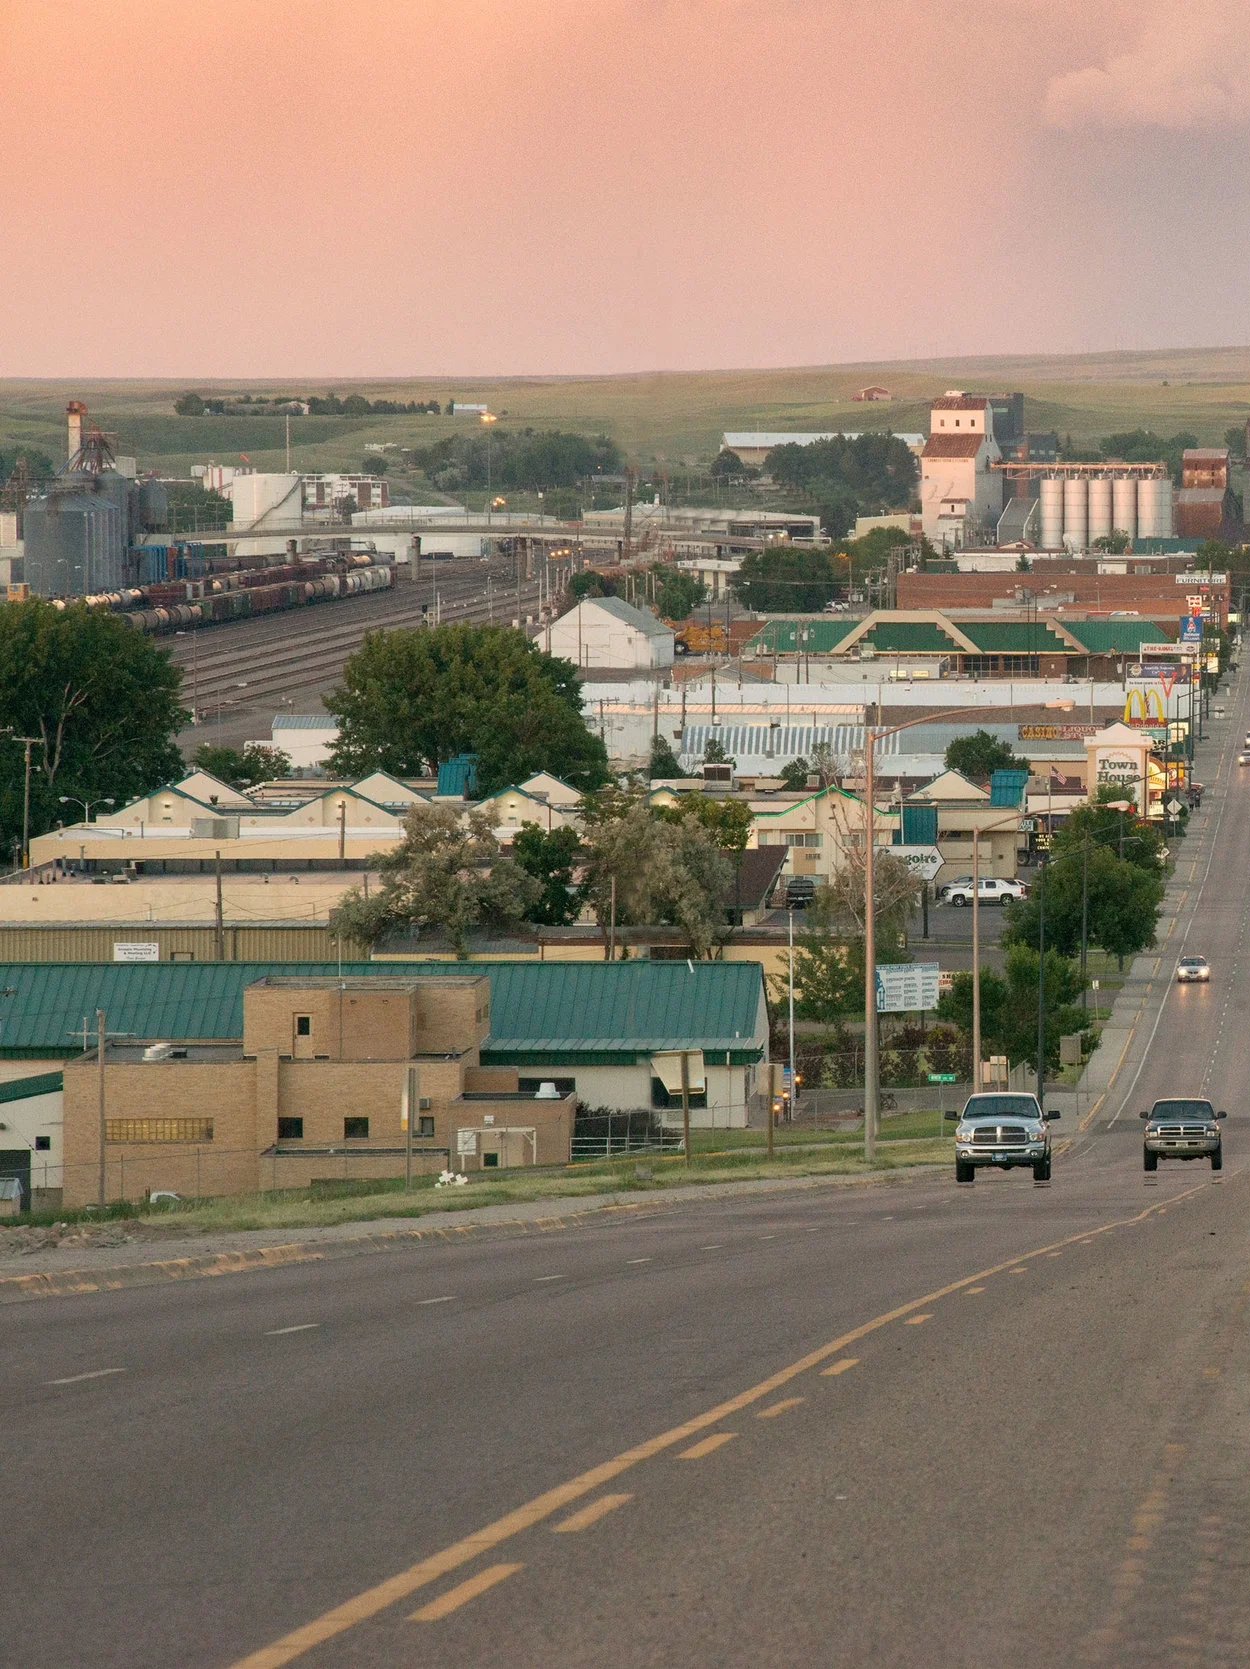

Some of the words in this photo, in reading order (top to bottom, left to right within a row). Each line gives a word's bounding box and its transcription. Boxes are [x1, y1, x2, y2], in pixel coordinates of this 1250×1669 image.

[1022, 726, 1058, 739] CASINO
[1098, 759, 1138, 770] Town
[1097, 771, 1141, 782] House
